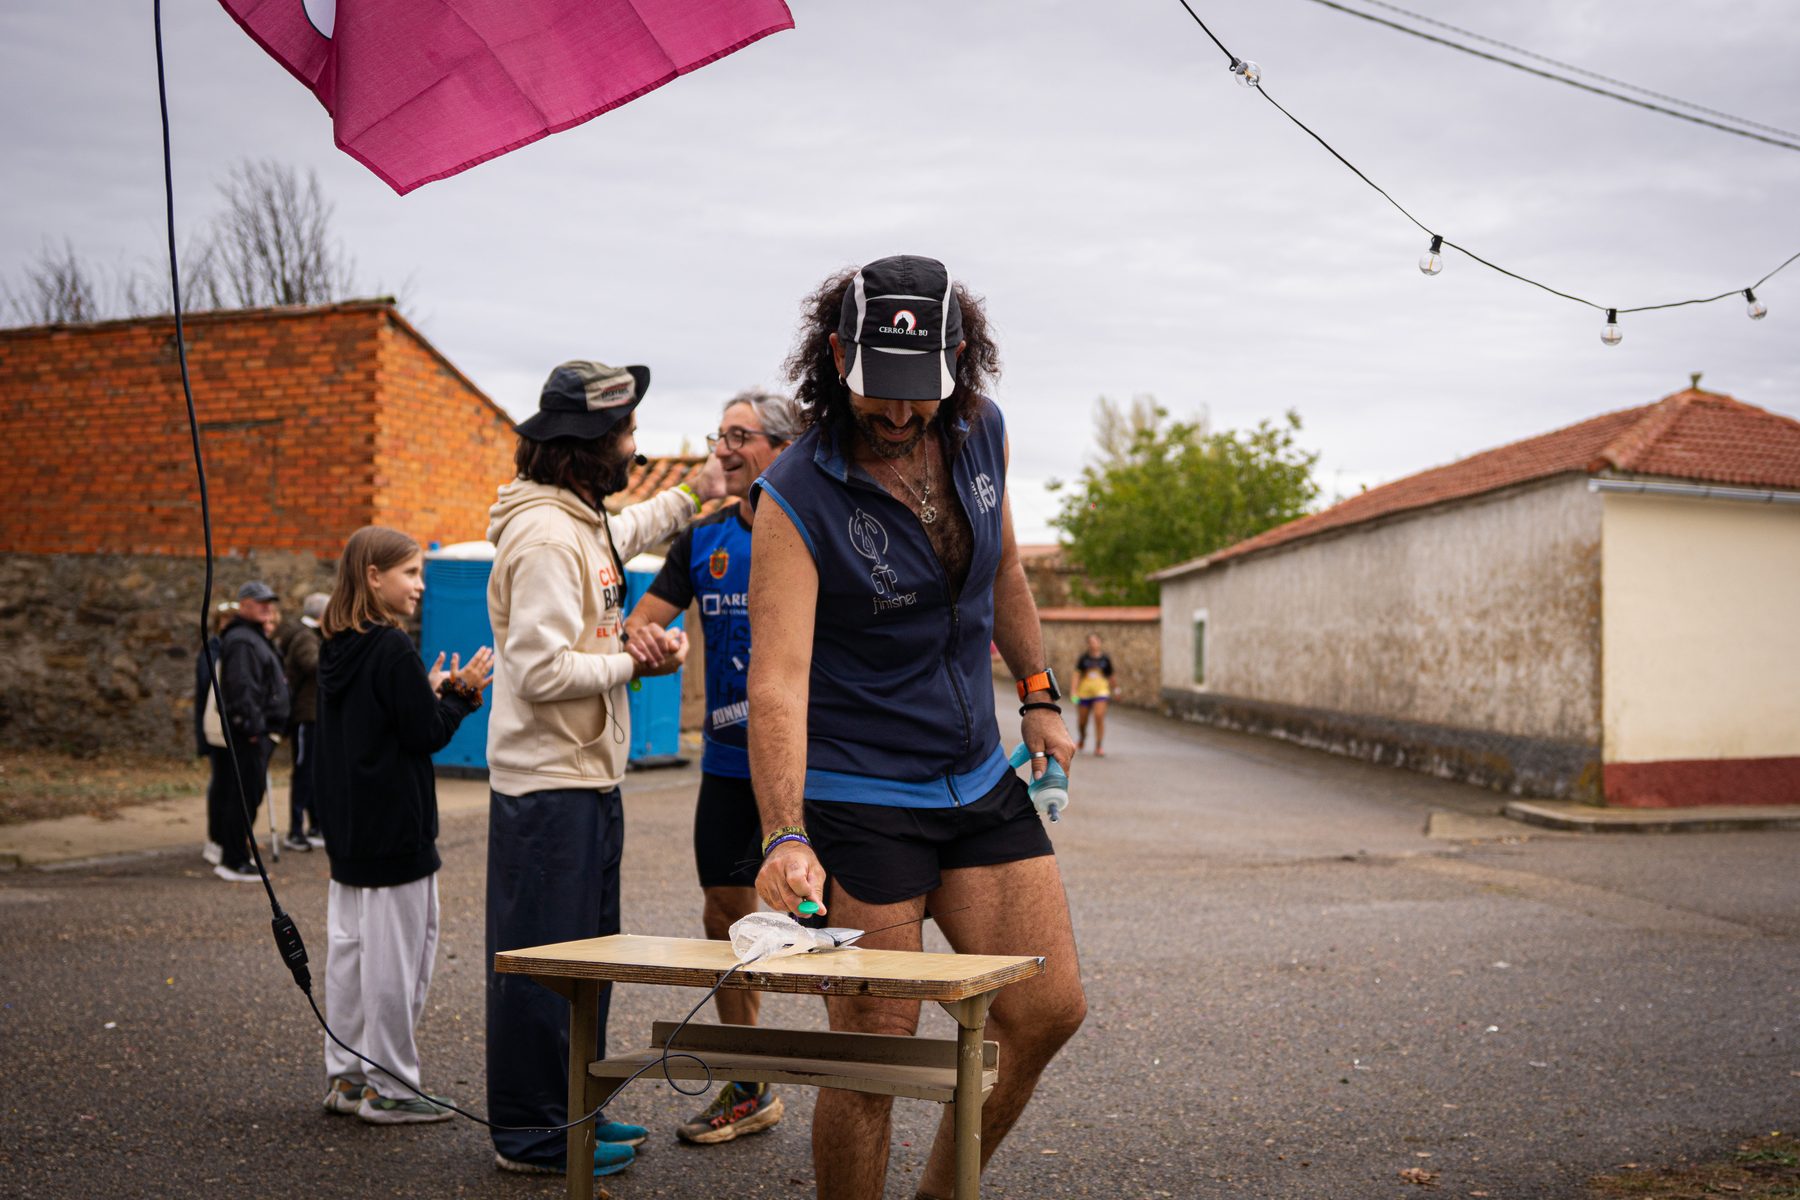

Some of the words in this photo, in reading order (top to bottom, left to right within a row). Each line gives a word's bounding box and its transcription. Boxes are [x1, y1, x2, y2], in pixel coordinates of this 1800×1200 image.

[879, 326, 904, 334] CERRO
[870, 569, 898, 595] GTP
[872, 592, 917, 615] finisher
[596, 627, 608, 638] EL
